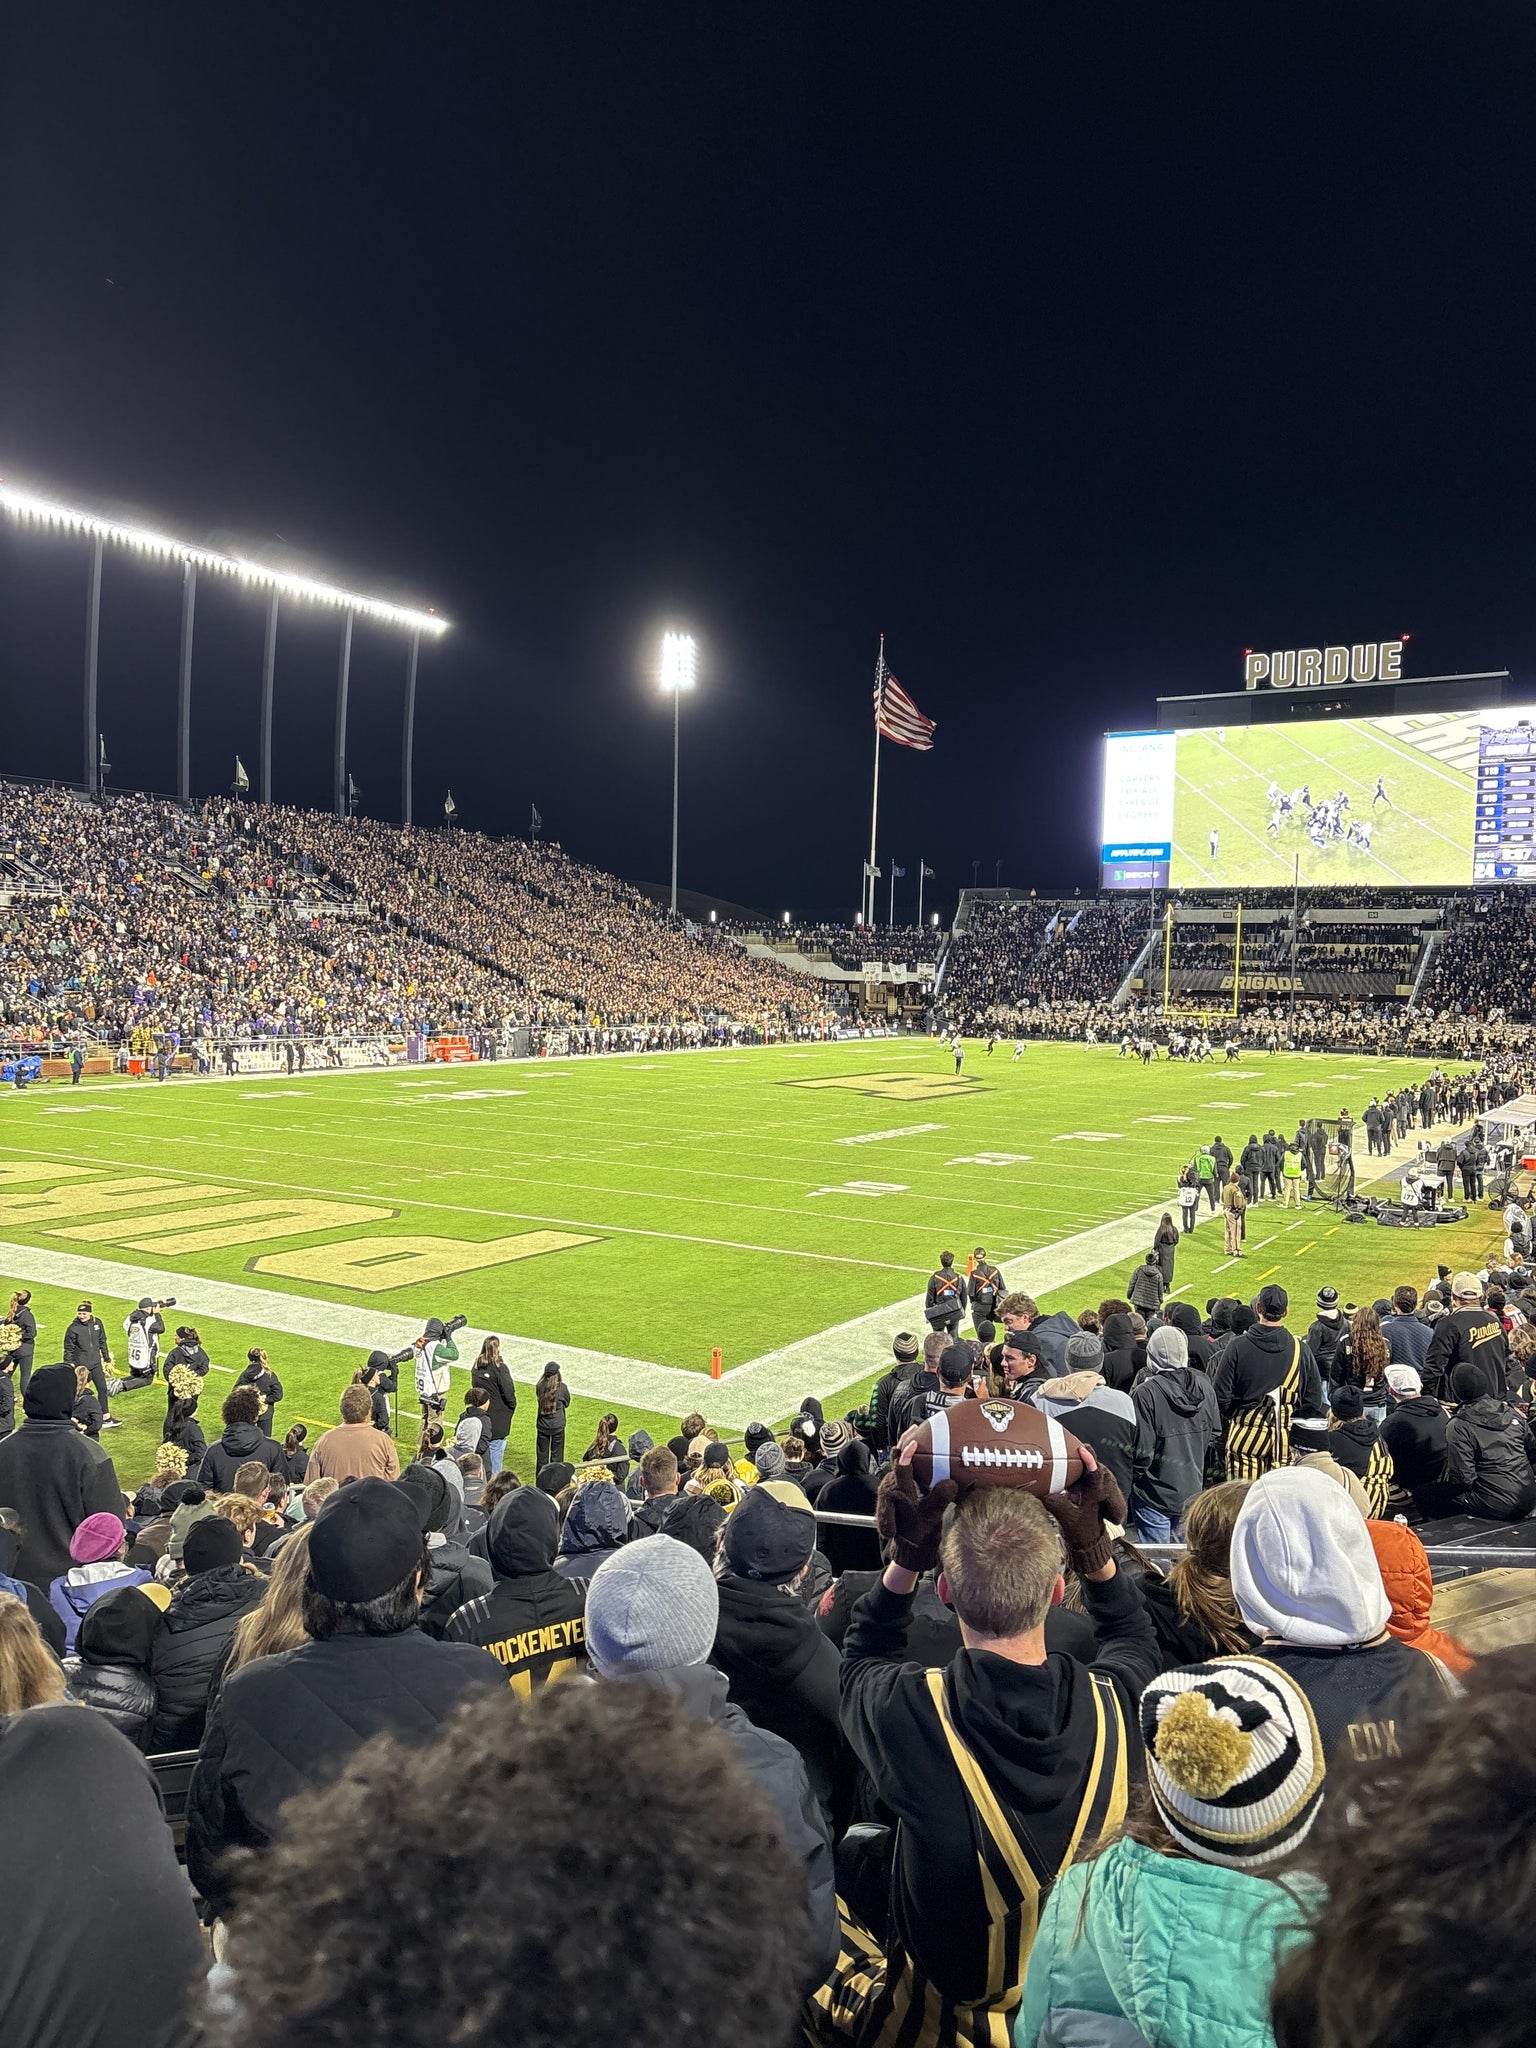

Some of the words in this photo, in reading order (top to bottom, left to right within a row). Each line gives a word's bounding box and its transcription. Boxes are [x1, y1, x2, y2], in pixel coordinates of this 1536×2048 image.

[1246, 641, 1402, 690] PURDUE
[1220, 975, 1305, 991] BRIGADE
[818, 1180, 911, 1197] 10
[1468, 1321, 1500, 1342] Purdue
[481, 1617, 586, 1666] OCKEMEYE
[1347, 1720, 1401, 1762] COX
